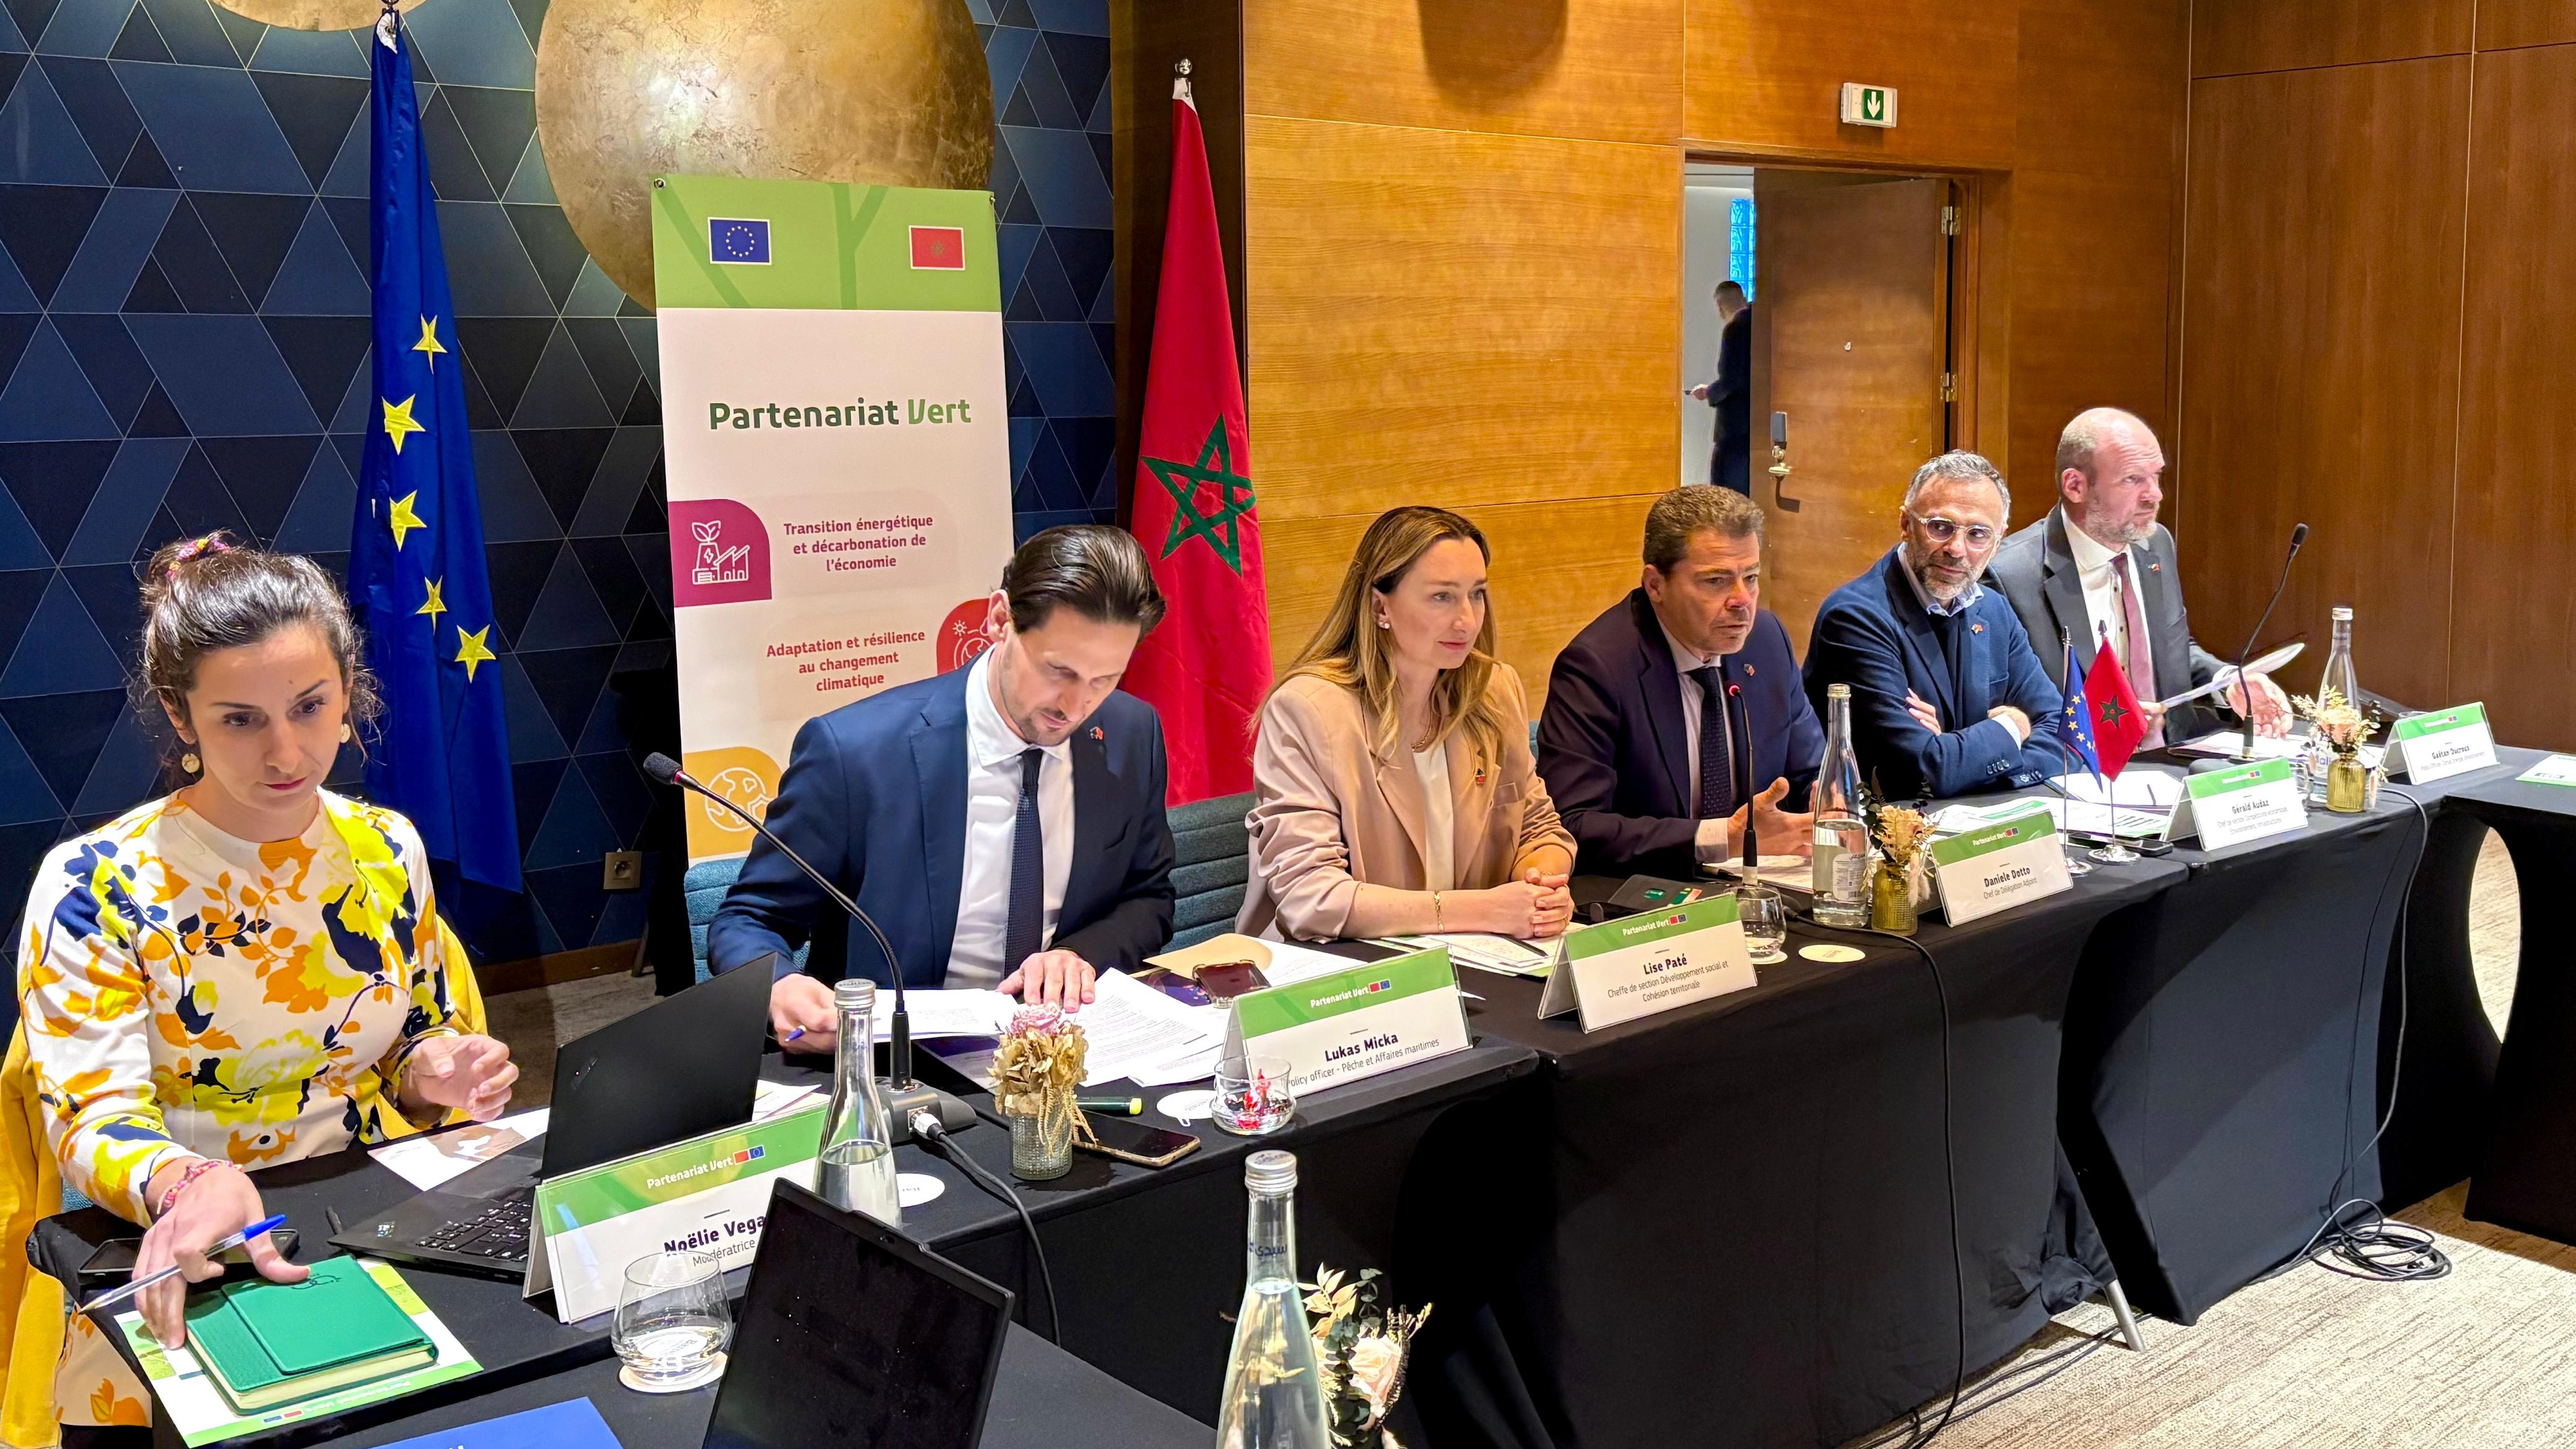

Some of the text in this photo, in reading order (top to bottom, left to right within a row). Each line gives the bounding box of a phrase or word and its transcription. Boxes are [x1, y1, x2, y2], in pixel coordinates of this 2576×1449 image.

[710, 398, 971, 429] Partenariat Vert
[784, 515, 933, 536] Transition énergétique
[793, 534, 926, 555] et décarbonation de
[767, 630, 925, 658] Adaptation et résilience
[799, 651, 899, 674] au changement
[816, 673, 884, 692] climatique
[2232, 799, 2269, 814] Gérald Audaz
[1984, 867, 2030, 887] Daniele Dotto
[1983, 889, 1994, 899] Chef
[1622, 919, 1669, 936] Partenariat Vert
[1643, 953, 1687, 975] Lise Paté
[1608, 986, 1628, 998] Cheffe
[1638, 978, 1660, 990] section
[1660, 967, 1704, 983] Développement
[1705, 962, 1721, 973] social
[1643, 980, 1700, 1002] Cohésion territoriale
[1310, 986, 1369, 1007] Partenariat Vert
[1325, 1033, 1398, 1062] Lukas Micka
[1310, 1067, 1335, 1081] officer
[1342, 1060, 1364, 1073] Pêche
[1365, 1056, 1373, 1066] et
[1375, 1049, 1403, 1064] Affaires
[1404, 1038, 1440, 1055] maritimes
[647, 1156, 733, 1188] Partenariat Vert
[664, 1229, 720, 1257] Noëlie
